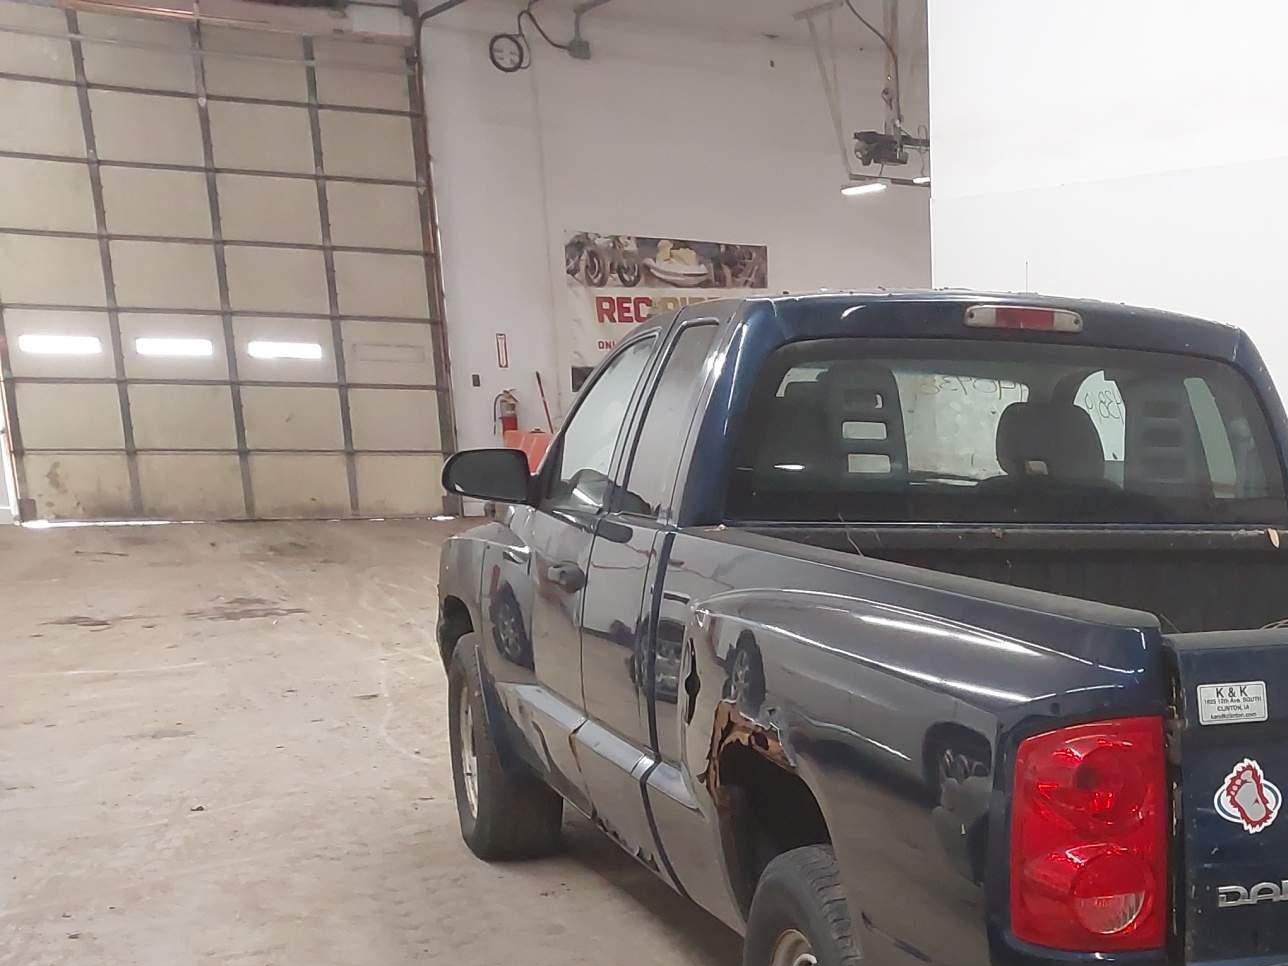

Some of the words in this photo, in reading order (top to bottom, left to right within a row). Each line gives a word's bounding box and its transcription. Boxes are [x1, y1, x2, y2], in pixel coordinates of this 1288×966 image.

[596, 296, 653, 323] REC
[1216, 688, 1224, 698] K
[1228, 687, 1236, 697] &
[1240, 686, 1248, 697] K
